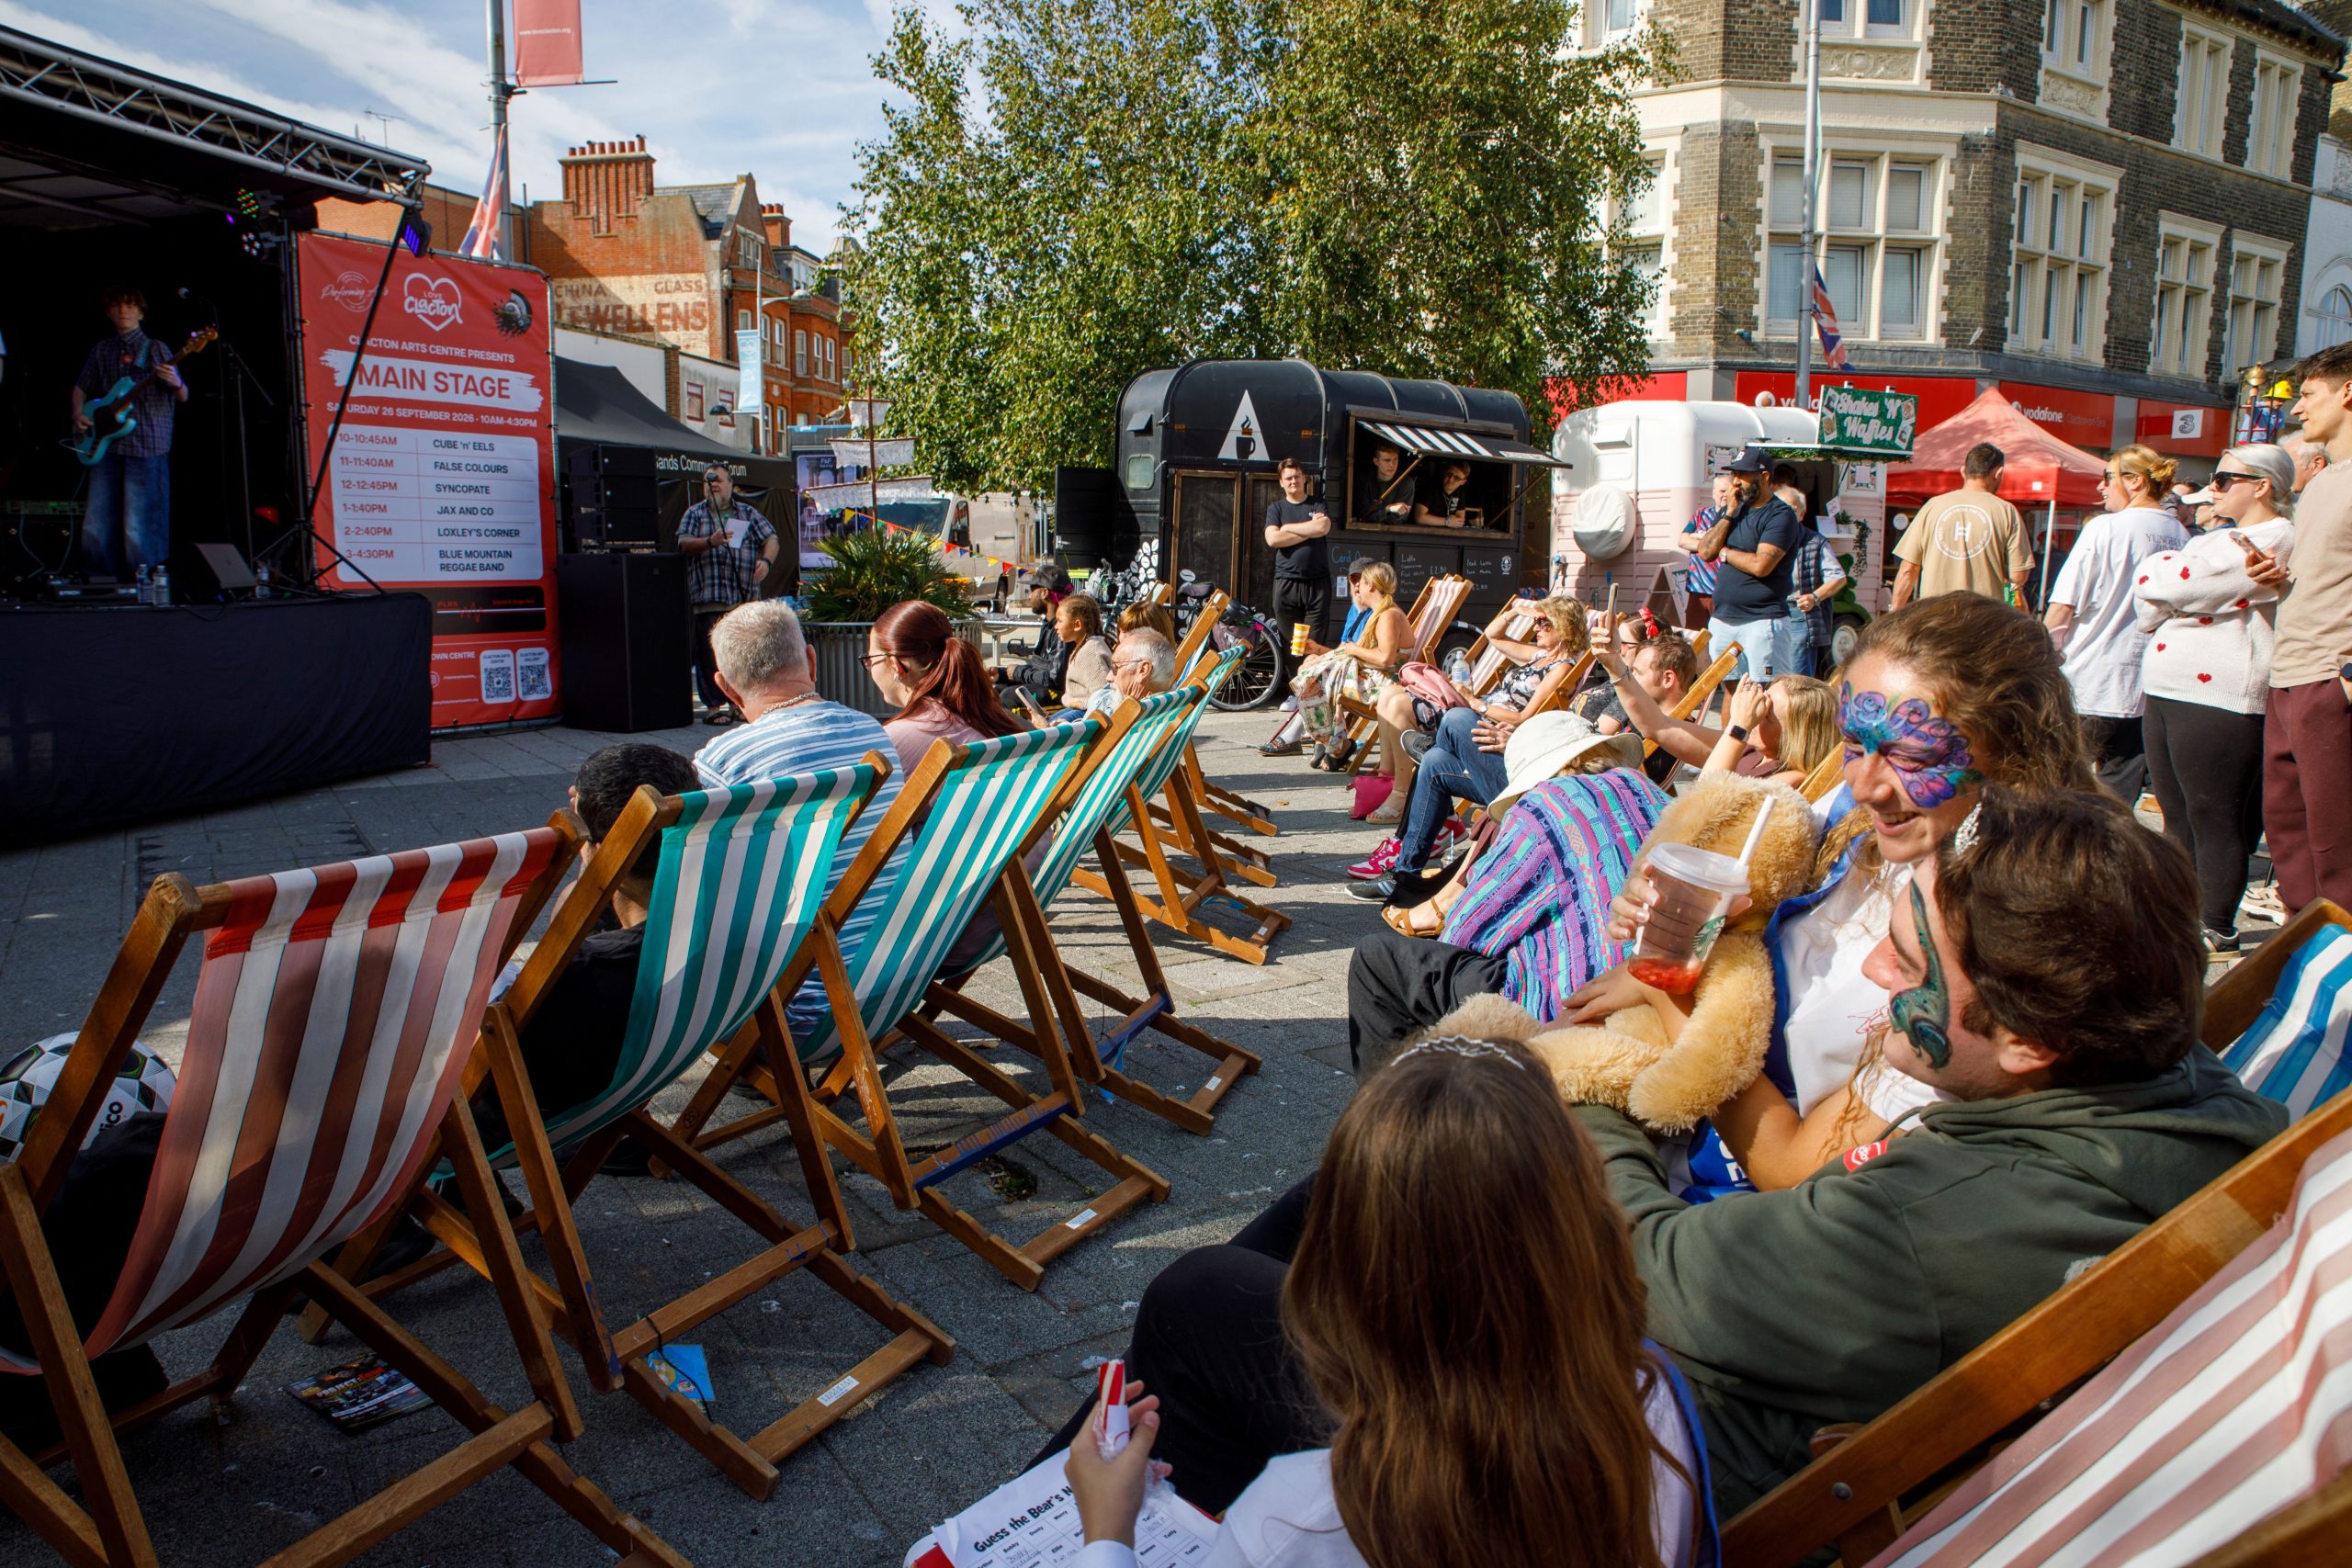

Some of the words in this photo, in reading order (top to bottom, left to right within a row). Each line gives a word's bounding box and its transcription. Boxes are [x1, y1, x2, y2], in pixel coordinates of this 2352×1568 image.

[424, 291, 443, 299] LOVE
[554, 284, 607, 299] CHINA
[654, 279, 704, 295] GLASS
[401, 340, 427, 354] ARTS
[429, 344, 467, 358] CENTRE
[468, 349, 514, 364] PRESENTS
[357, 362, 426, 392] MAIN
[434, 371, 511, 400] STAGE
[1836, 393, 1880, 416] Shakes
[326, 402, 379, 415] SAURDAY
[396, 407, 450, 421] SEPTEMBER
[481, 414, 537, 427] 10AM-4:30PM
[2024, 406, 2064, 423] vodafone
[1843, 416, 1894, 445] Waffles
[338, 433, 397, 446] 10-10:45AM
[433, 439, 458, 450] CUBE
[472, 441, 495, 452] EELS
[340, 456, 394, 468] 11-11:40AM
[434, 461, 463, 472] FALSE
[465, 462, 508, 474] COLOURS
[341, 479, 397, 491] 12-12:45PM
[435, 483, 491, 495] SYNCOPATE
[343, 502, 387, 514] 1-1:40PM
[437, 506, 457, 516] JAX
[458, 506, 479, 516] AND
[480, 506, 494, 516] CO
[345, 525, 392, 537] 2-2:40PM
[437, 527, 482, 538] LOXLEY'S
[483, 528, 520, 538] CORNER
[346, 549, 394, 559] 3-4:30PM
[439, 549, 463, 560] BLUE
[465, 549, 513, 560] MOUNTAIN
[440, 562, 479, 572] REGGAE
[479, 562, 504, 572] BAND
[432, 651, 448, 660] OWN
[449, 651, 476, 660] CENTRE
[973, 1527, 1011, 1552] Guess
[1009, 1515, 1030, 1531] the
[1027, 1493, 1065, 1519] Bear's
